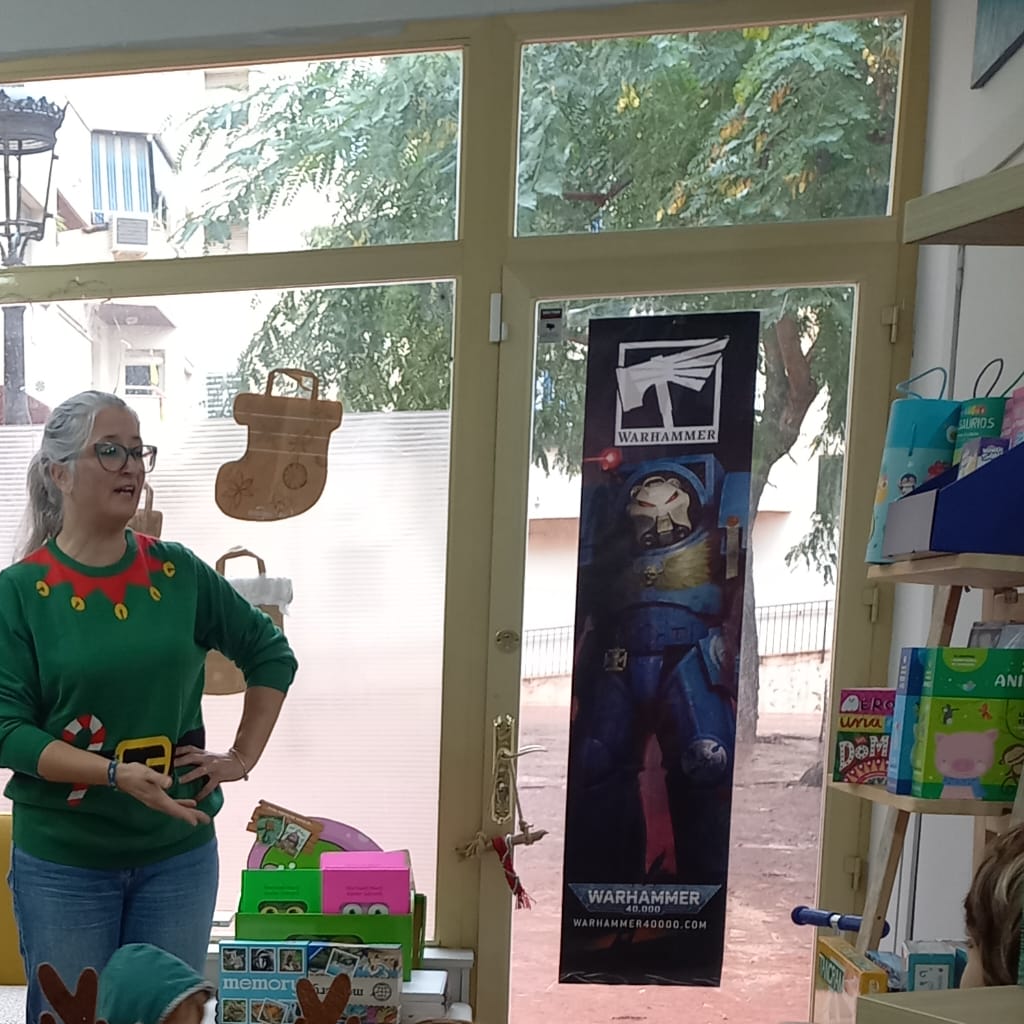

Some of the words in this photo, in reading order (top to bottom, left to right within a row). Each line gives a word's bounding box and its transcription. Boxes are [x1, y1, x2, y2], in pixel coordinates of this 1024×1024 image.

[617, 429, 717, 443] WARHAMMER
[839, 715, 882, 729] una
[587, 889, 701, 906] WARHAMMER
[573, 918, 708, 930] WARHAMMER40000.COM
